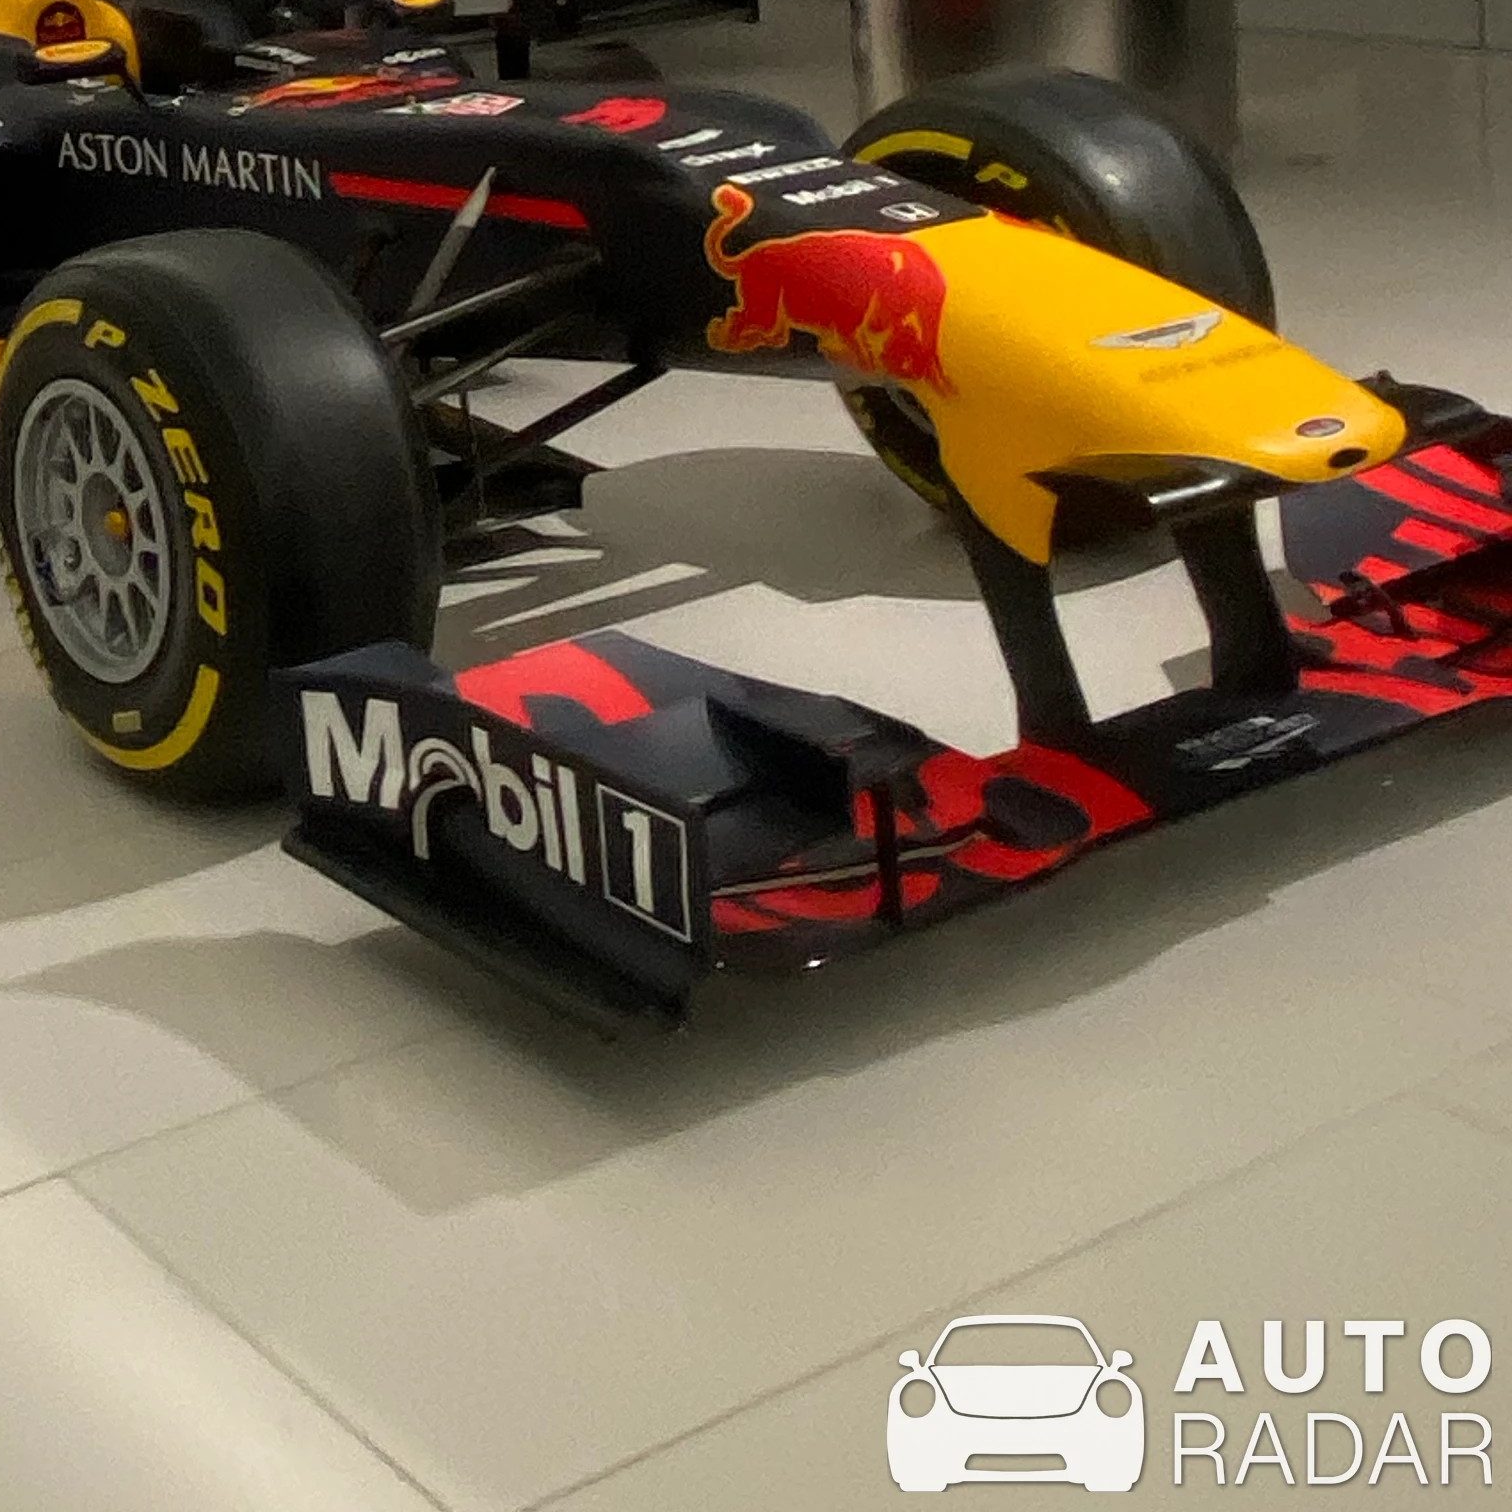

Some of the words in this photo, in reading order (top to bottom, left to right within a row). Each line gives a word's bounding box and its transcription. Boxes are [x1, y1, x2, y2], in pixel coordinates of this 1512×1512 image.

[58, 131, 168, 178] ASTON
[182, 142, 322, 200] MARTIN
[84, 319, 127, 349] P
[130, 367, 228, 636] ZERO
[300, 690, 586, 887] Mobil
[622, 809, 656, 913] 1
